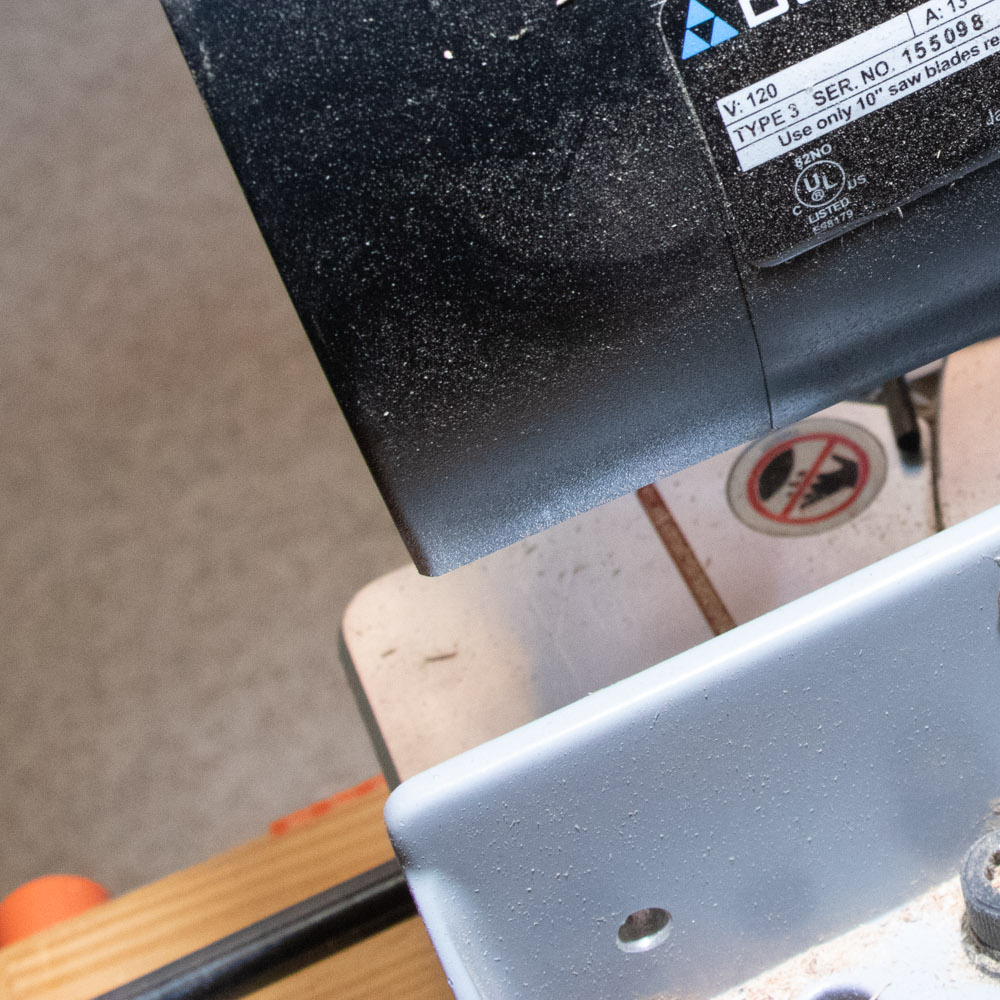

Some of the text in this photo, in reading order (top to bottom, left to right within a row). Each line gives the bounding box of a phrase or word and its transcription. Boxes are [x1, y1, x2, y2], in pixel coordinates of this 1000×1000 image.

[921, 5, 944, 25] A:
[732, 107, 786, 144] TYPE
[786, 102, 801, 119] 3
[811, 74, 858, 107] SER.
[859, 57, 895, 85] NO.
[900, 13, 986, 65] 155098
[723, 81, 779, 118] V: 120
[777, 120, 814, 148] Use
[814, 101, 855, 132] only
[852, 85, 886, 112] 10"
[886, 70, 923, 97] saw
[923, 42, 980, 79] blades
[793, 142, 833, 168] 82NO
[802, 167, 838, 196] UL
[807, 196, 852, 224] LISTED
